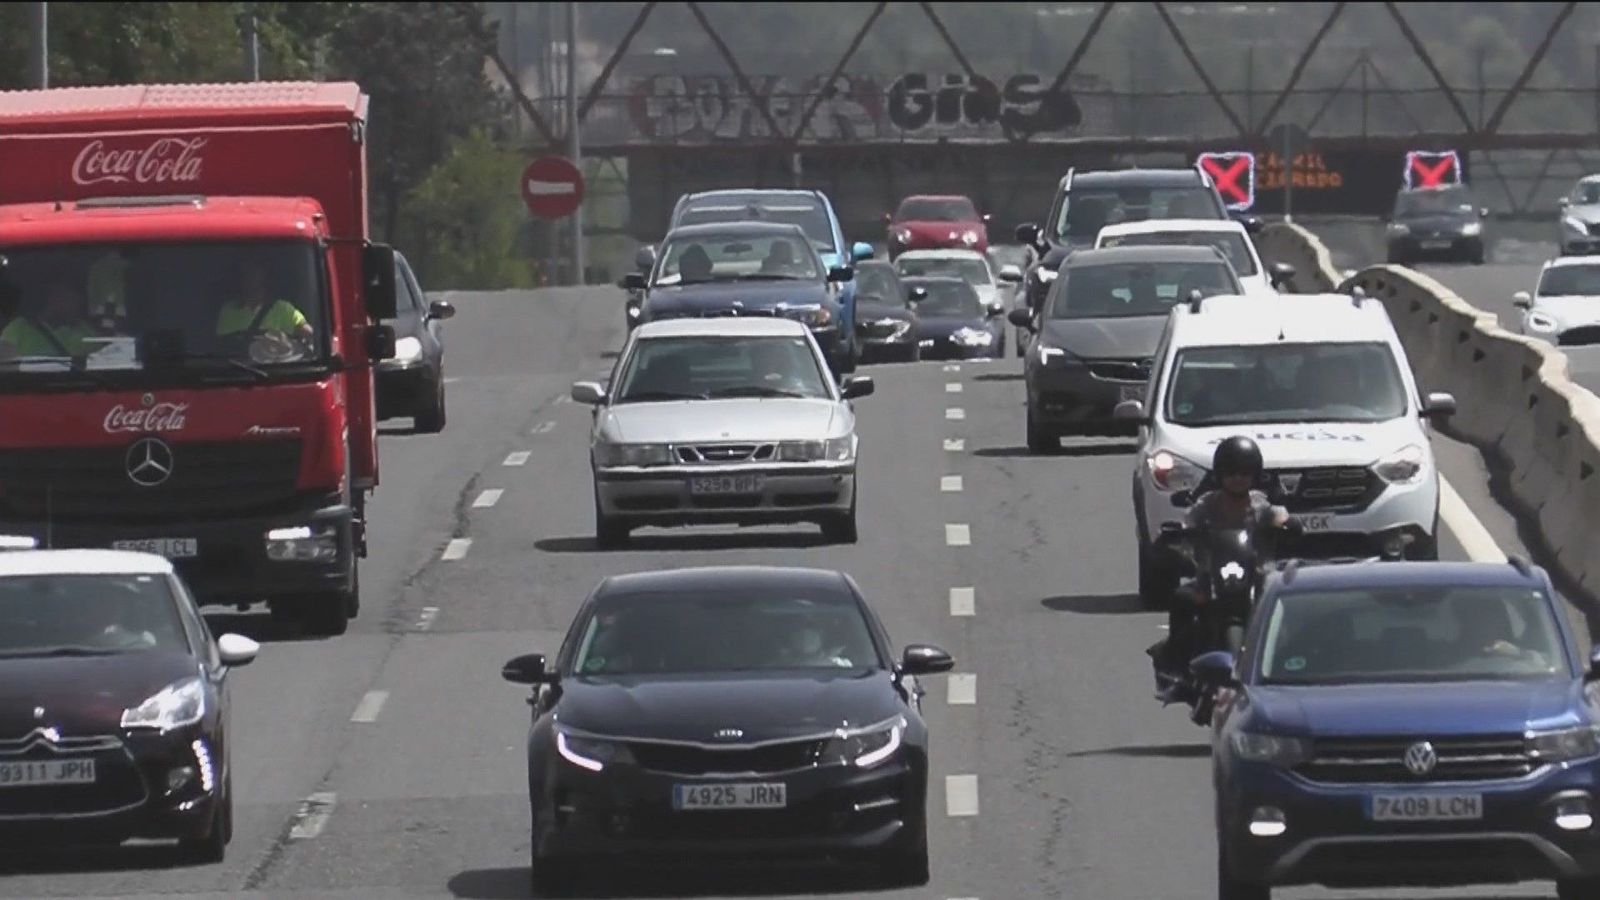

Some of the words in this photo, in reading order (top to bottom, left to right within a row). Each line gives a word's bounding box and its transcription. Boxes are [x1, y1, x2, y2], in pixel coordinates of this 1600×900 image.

[54, 761, 93, 780] JPH
[687, 787, 736, 805] 4925
[744, 785, 783, 804] JRN
[1377, 797, 1429, 816] 7409
[1435, 796, 1477, 816] LCH
